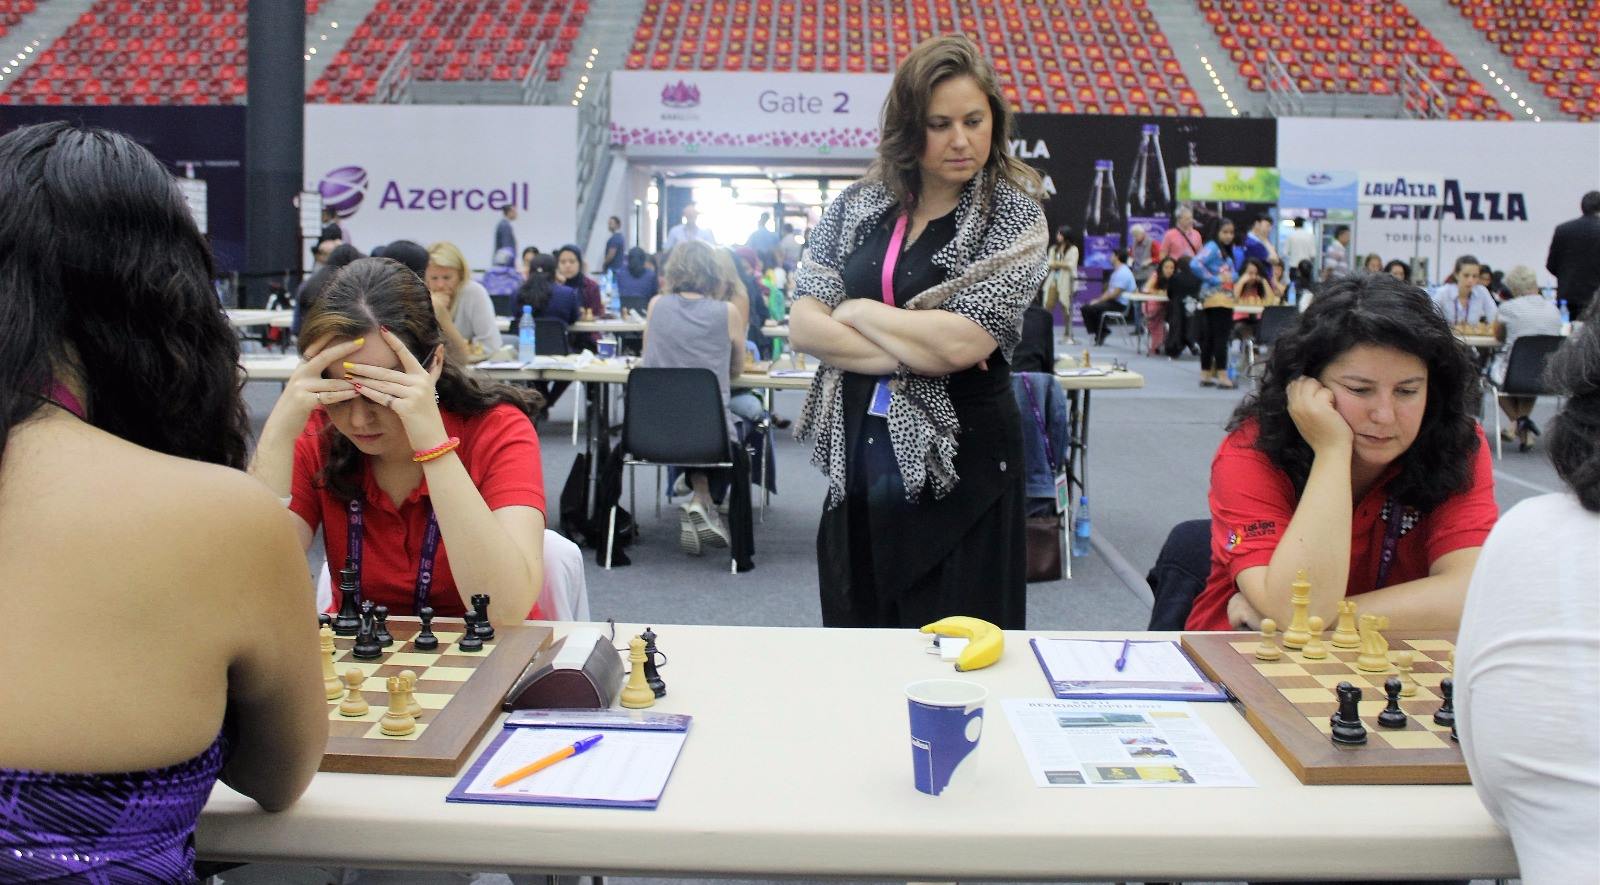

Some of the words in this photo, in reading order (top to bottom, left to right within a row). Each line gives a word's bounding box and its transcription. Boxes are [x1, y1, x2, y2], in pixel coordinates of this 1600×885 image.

[758, 90, 823, 114] Gate
[833, 92, 850, 114] 2
[379, 180, 530, 211] Azercell
[1364, 177, 1437, 197] LAVAZZA
